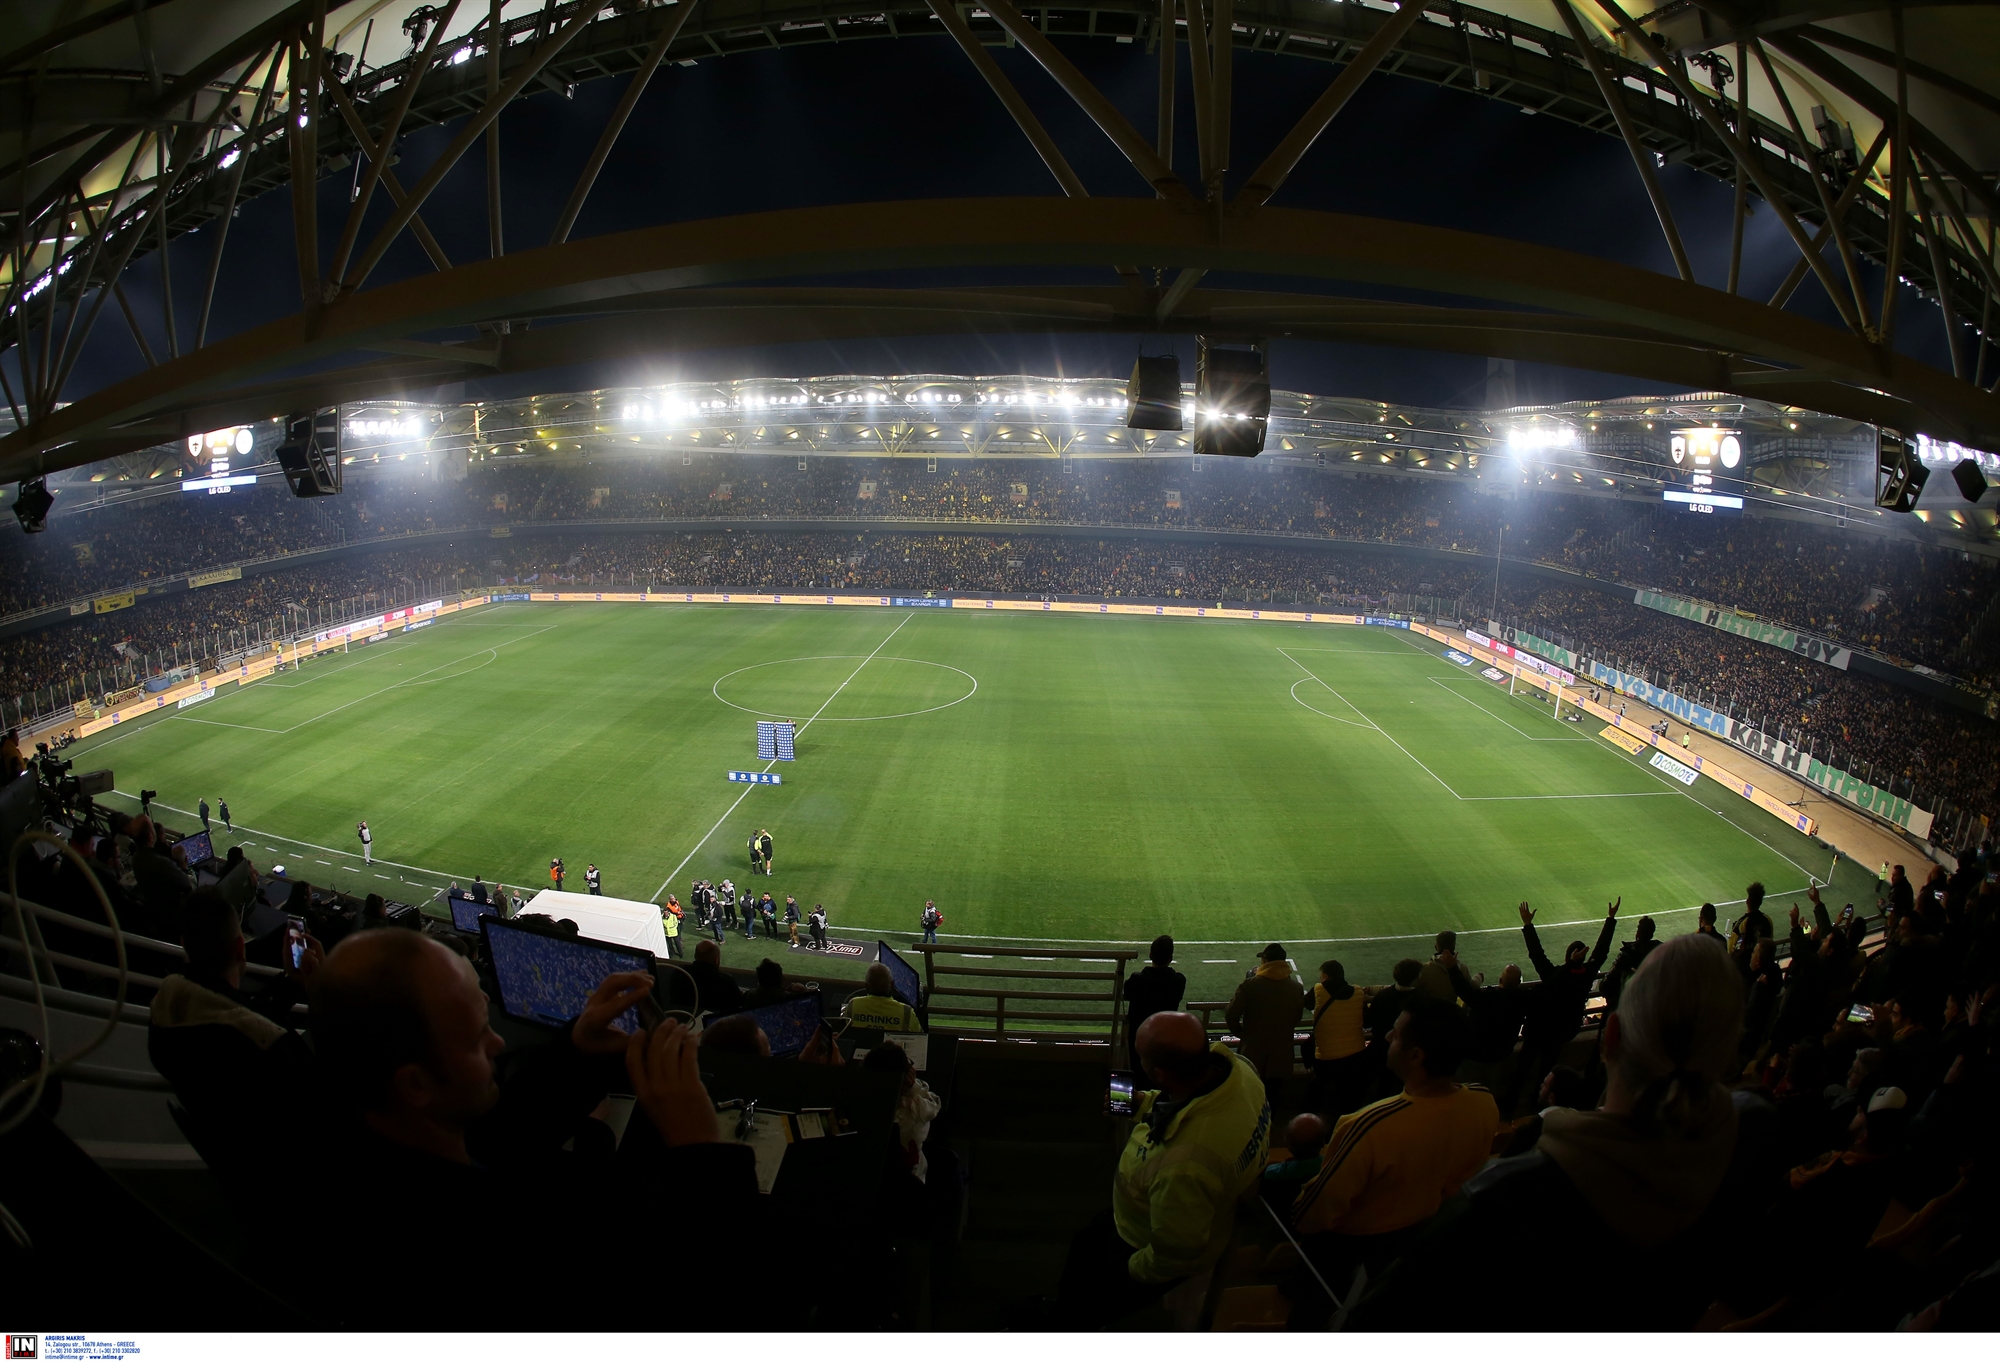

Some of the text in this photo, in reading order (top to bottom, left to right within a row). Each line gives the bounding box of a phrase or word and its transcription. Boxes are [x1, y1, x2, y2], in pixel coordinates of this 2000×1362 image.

[1705, 609, 1720, 626] Η
[1719, 613, 1795, 650] ΙΣΤΟΡΙΑ
[1793, 636, 1840, 664] ΣΟΥ
[1516, 630, 1570, 667] ΨΕΜΑ
[1594, 662, 1726, 735] ΡΟΥΦΙΑΝΙΑ
[1730, 720, 1778, 760] ΚΑΙ
[1781, 746, 1802, 772] Η
[1808, 758, 1914, 829] ΝΤΡΟΠΗ
[1660, 759, 1694, 783] COSMOTE
[859, 1013, 900, 1026] BRINKS
